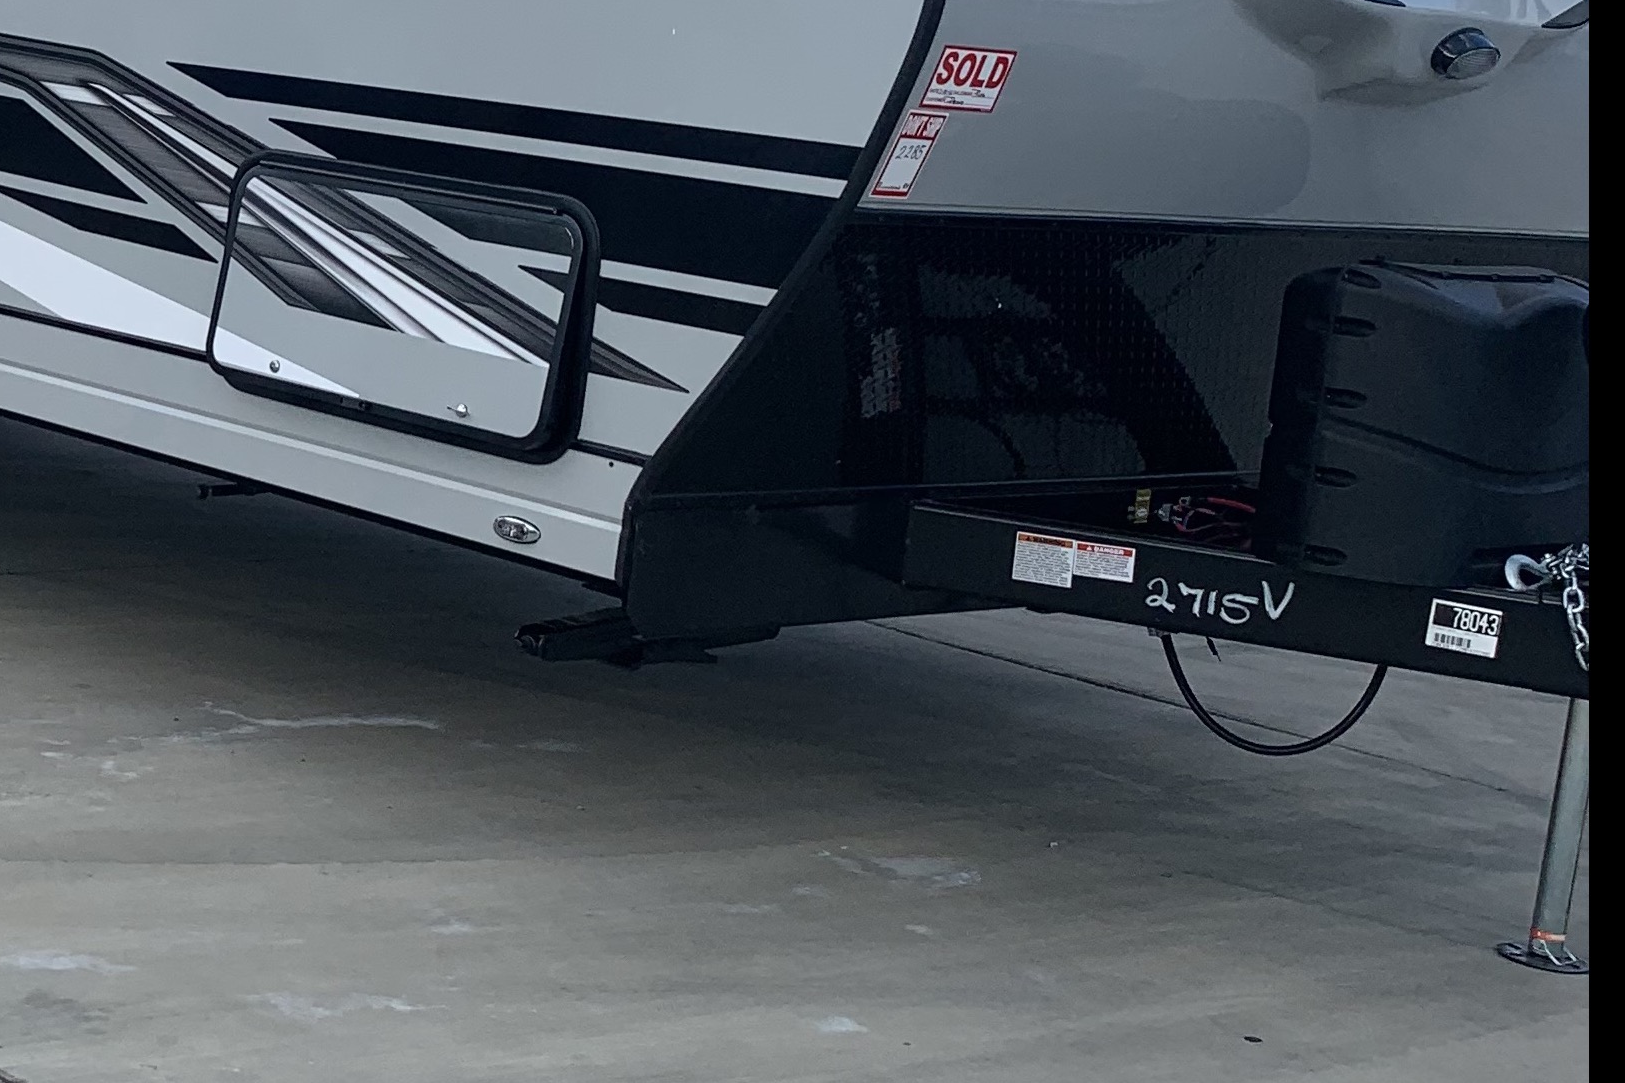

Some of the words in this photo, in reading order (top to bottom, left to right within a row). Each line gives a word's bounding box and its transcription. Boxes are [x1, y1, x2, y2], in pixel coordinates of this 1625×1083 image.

[936, 51, 1009, 89] SOLD
[895, 144, 927, 160] 2285
[1144, 577, 1295, 625] 2715V
[1452, 607, 1500, 636] 78043
